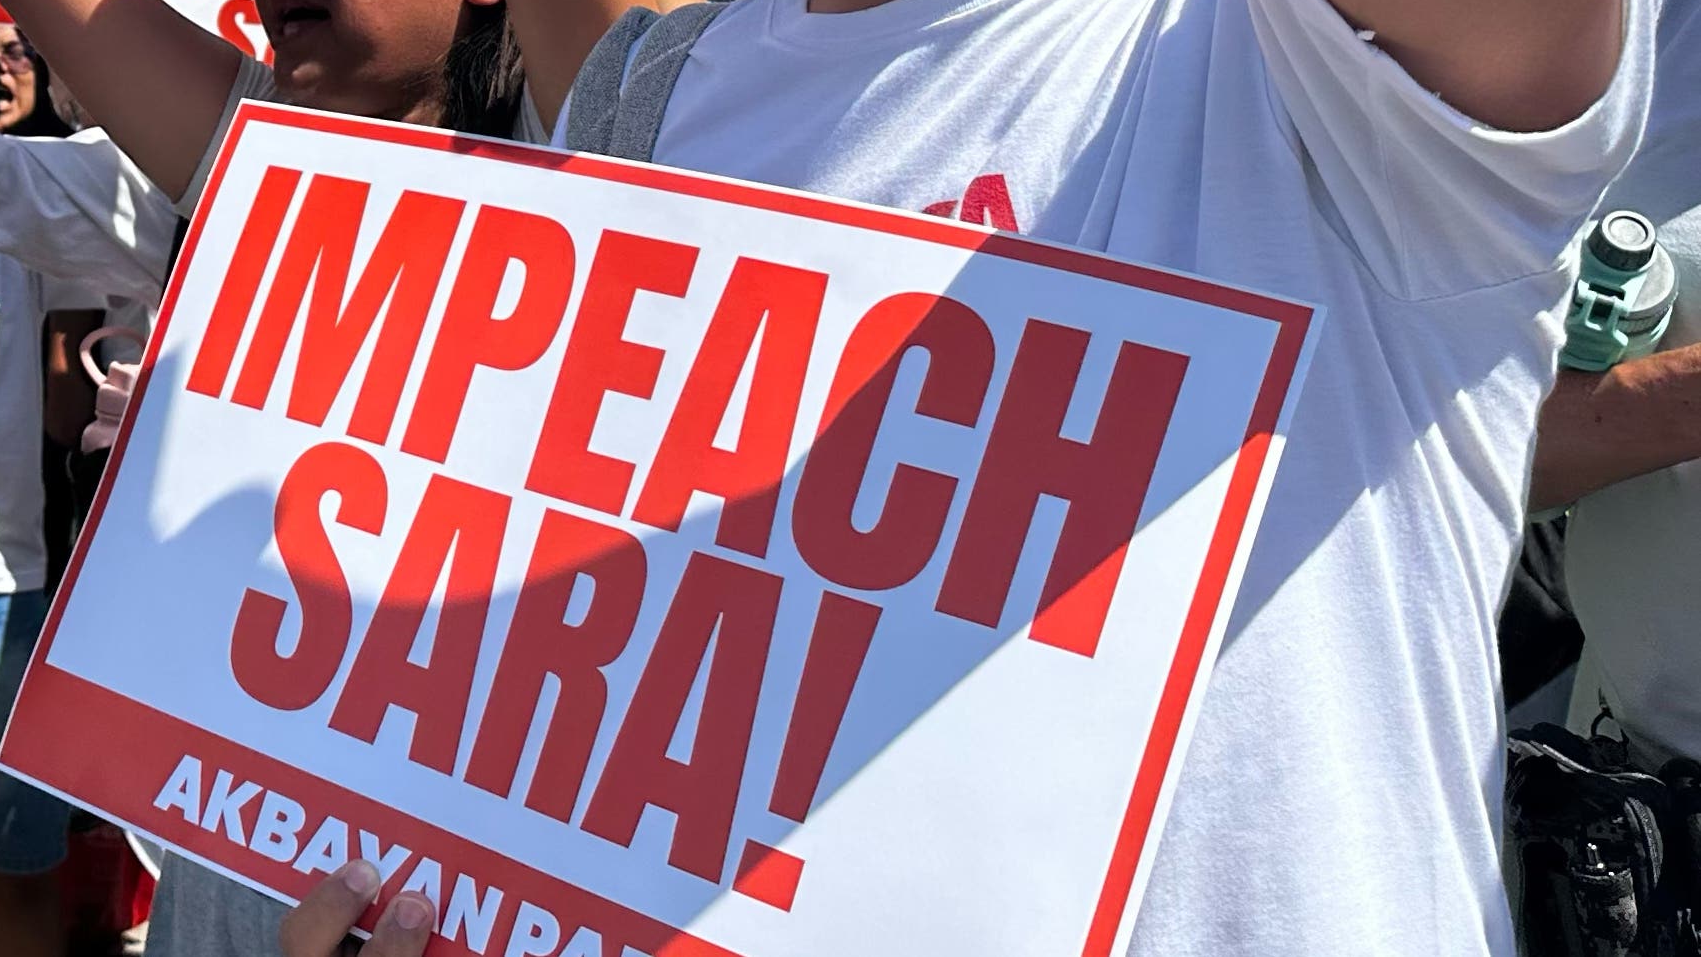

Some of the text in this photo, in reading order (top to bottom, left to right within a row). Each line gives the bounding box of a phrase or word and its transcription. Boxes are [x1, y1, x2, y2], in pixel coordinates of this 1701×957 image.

[186, 165, 1191, 659] IMPEACH
[153, 754, 504, 956] AKBAYAN
[230, 441, 882, 913] SARA!
